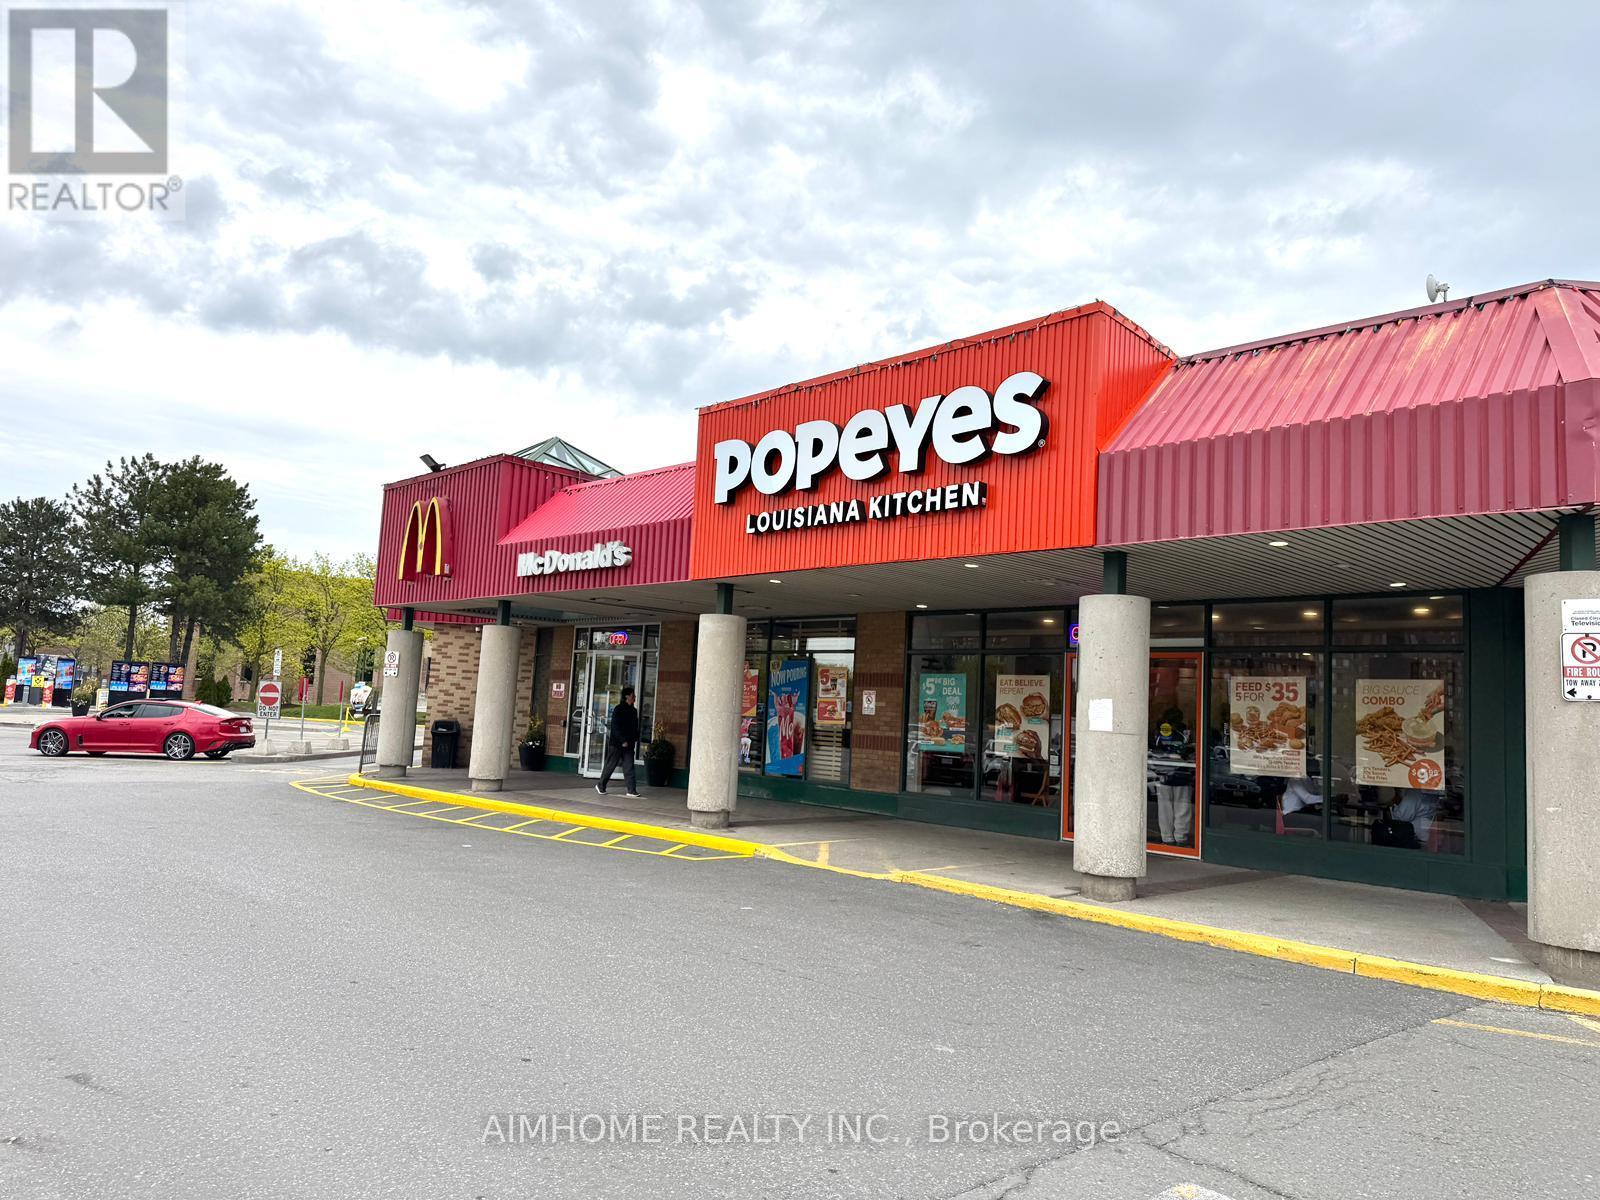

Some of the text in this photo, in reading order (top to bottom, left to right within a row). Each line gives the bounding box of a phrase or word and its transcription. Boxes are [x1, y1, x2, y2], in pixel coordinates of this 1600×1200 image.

[745, 499, 861, 535] LOUISIANA
[516, 540, 632, 577] McDonald's
[1566, 667, 1583, 677] FIRE
[770, 670, 786, 688] NOW
[943, 677, 955, 686] BIG
[1566, 679, 1578, 687] TOW
[1580, 679, 1596, 687] AWAY
[942, 687, 962, 696] DEAL
[1235, 682, 1262, 692] FEED
[1362, 685, 1420, 696] BIG SAUCE
[1235, 692, 1265, 702] 5 FOR
[1361, 696, 1405, 706] COMBO
